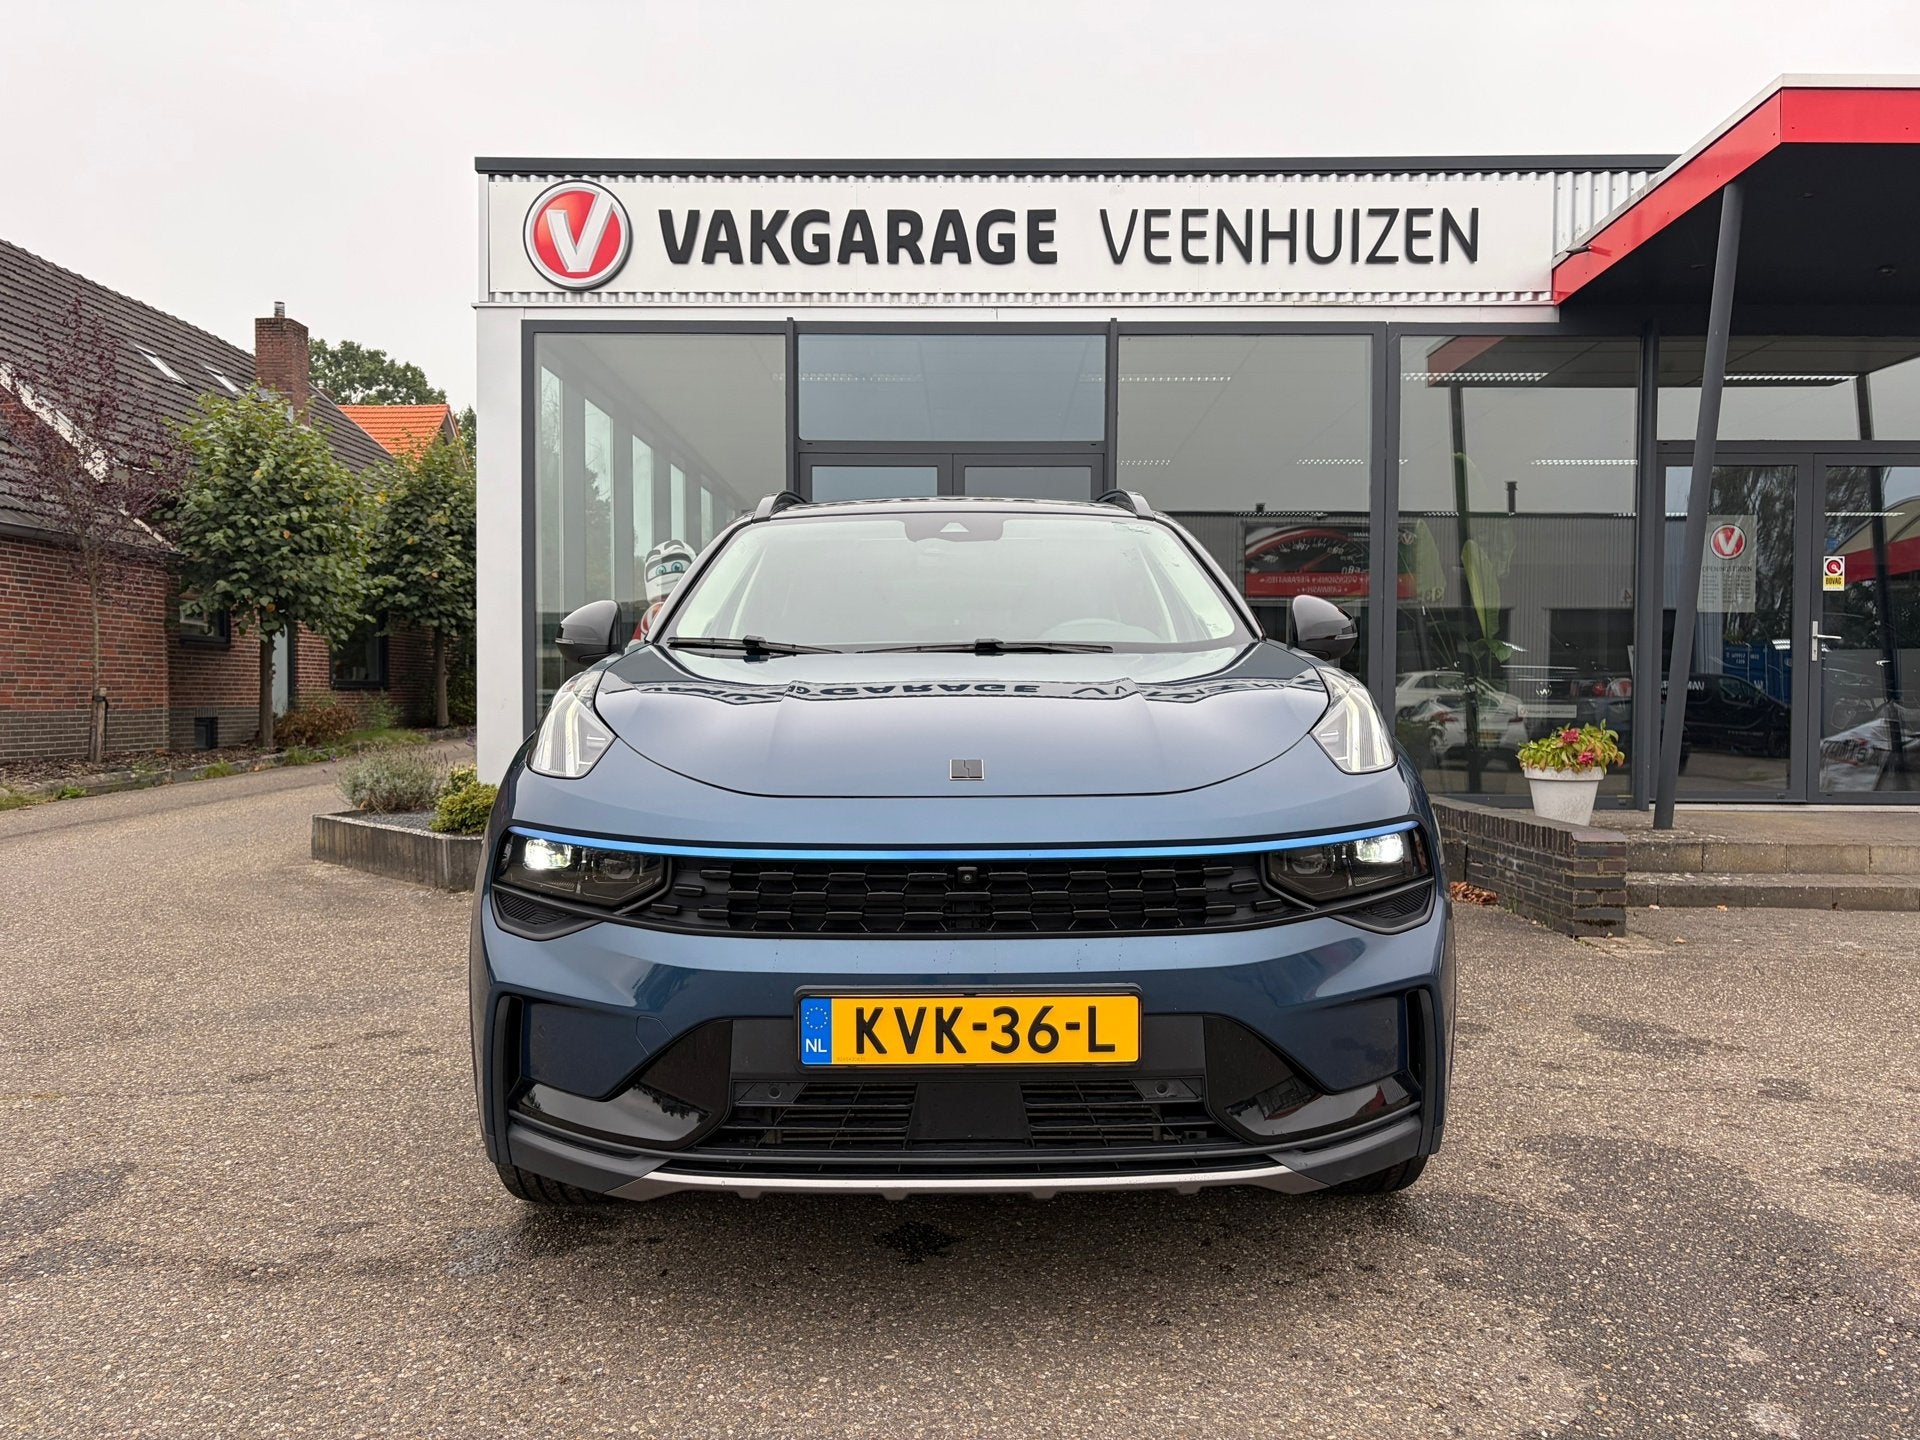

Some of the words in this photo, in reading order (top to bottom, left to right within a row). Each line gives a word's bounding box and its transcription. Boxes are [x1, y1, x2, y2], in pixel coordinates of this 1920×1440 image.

[545, 190, 615, 273] V
[658, 208, 1058, 265] VAKGARAGE
[1099, 207, 1479, 265] VEENHUIZEN
[1825, 577, 1842, 585] BOVAG
[805, 1038, 828, 1053] NL
[855, 1004, 1116, 1055] KVK-36-L
